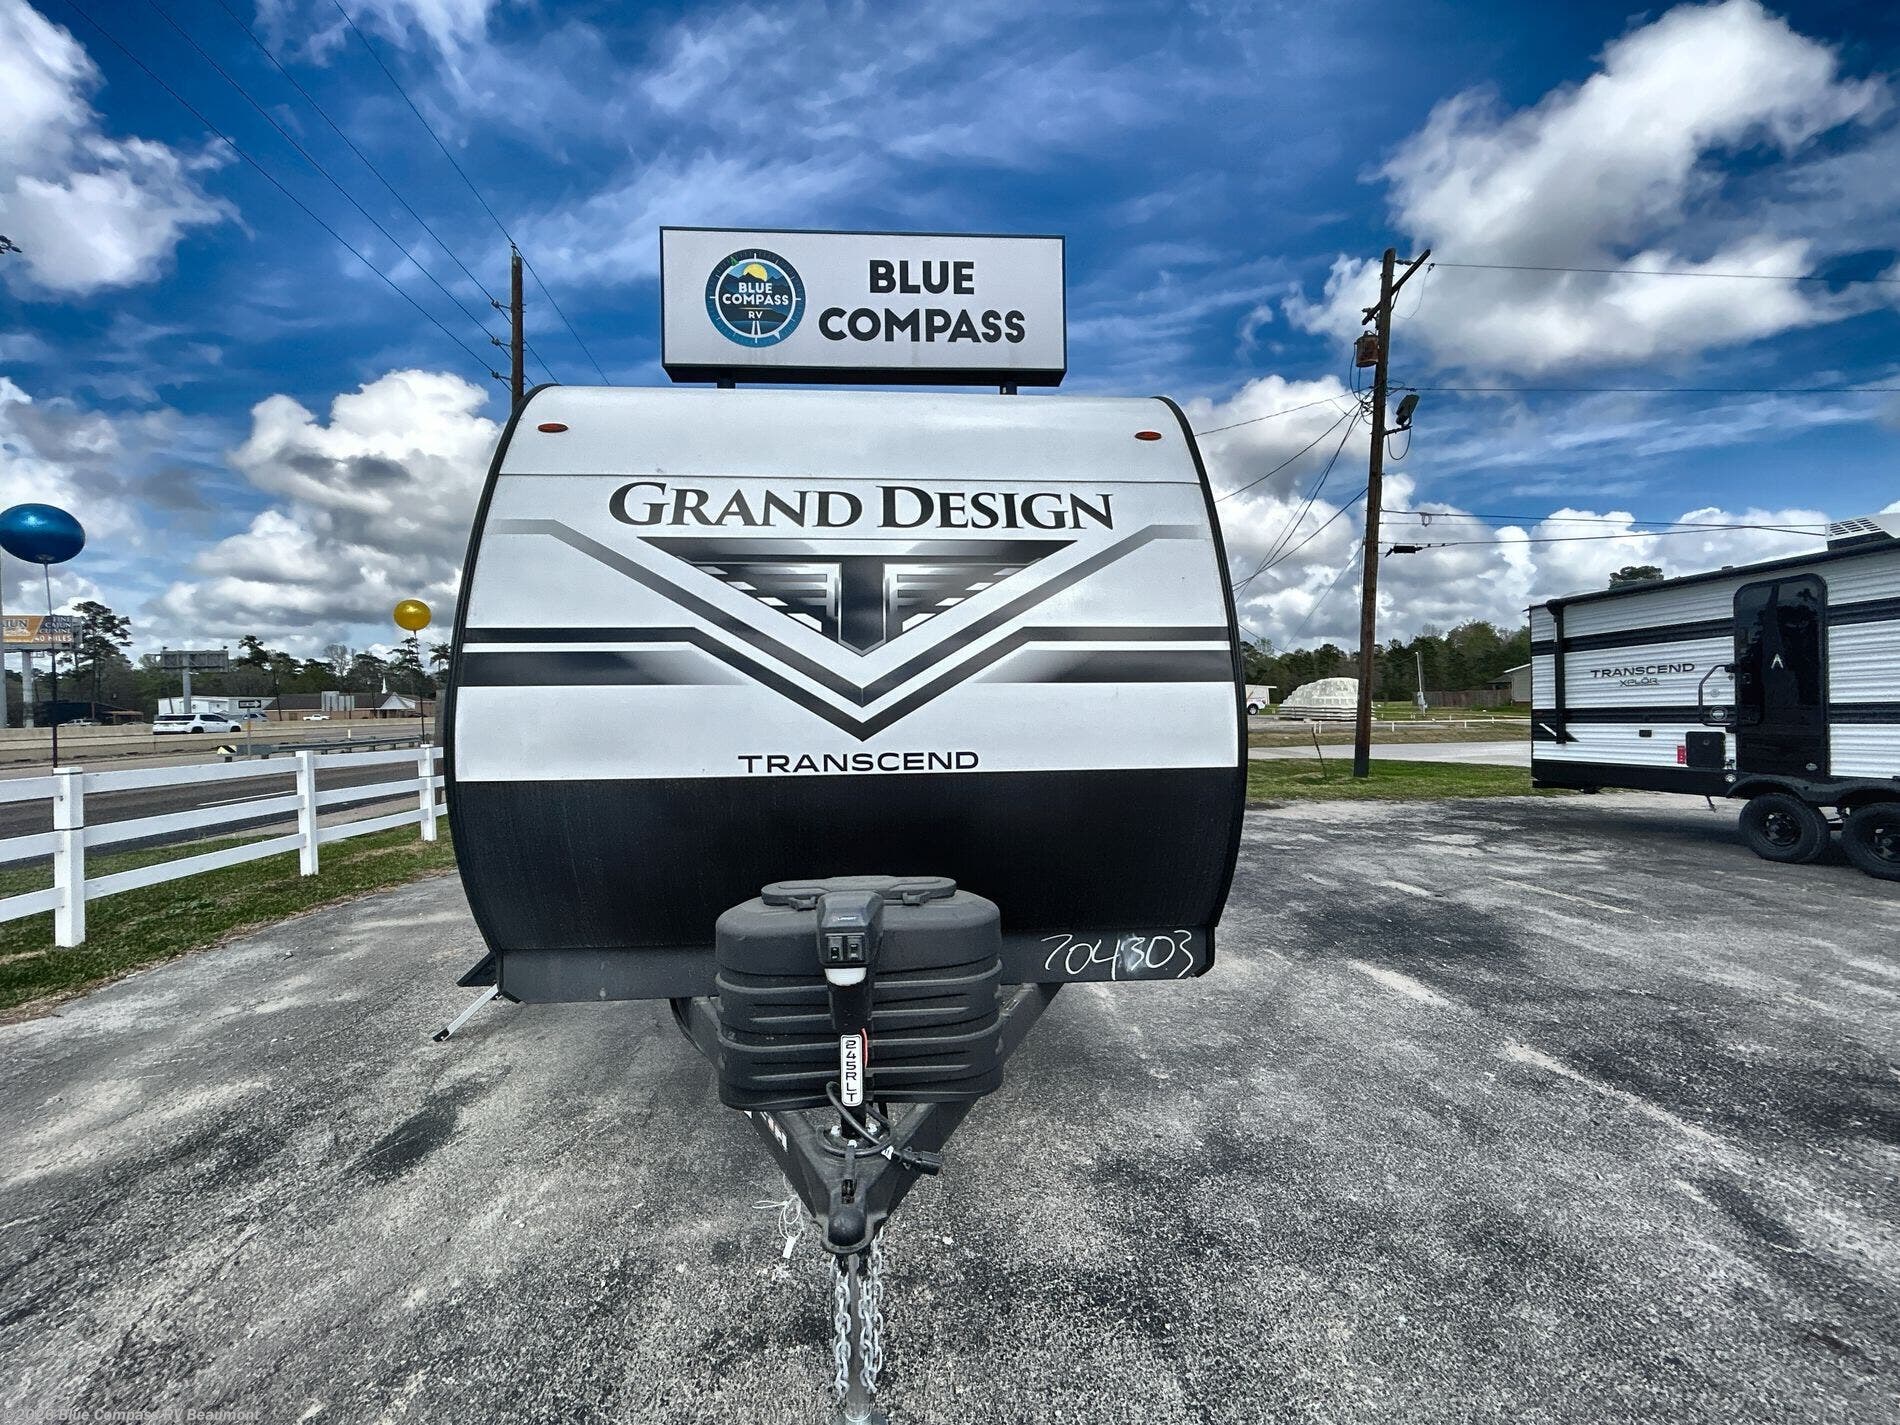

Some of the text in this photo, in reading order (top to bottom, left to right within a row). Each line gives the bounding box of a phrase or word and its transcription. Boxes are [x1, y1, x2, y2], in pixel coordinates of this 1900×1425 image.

[738, 281, 773, 294] BLUE
[869, 259, 975, 295] BLUE
[722, 293, 790, 306] COMPASS
[747, 310, 764, 319] RV
[818, 307, 1026, 344] COMPASS
[608, 481, 1115, 531] GRAND DESIGN
[1590, 663, 1696, 679] TRANSCEND
[738, 750, 980, 775] TRANSCEND
[844, 1039, 858, 1103] 245RLT
